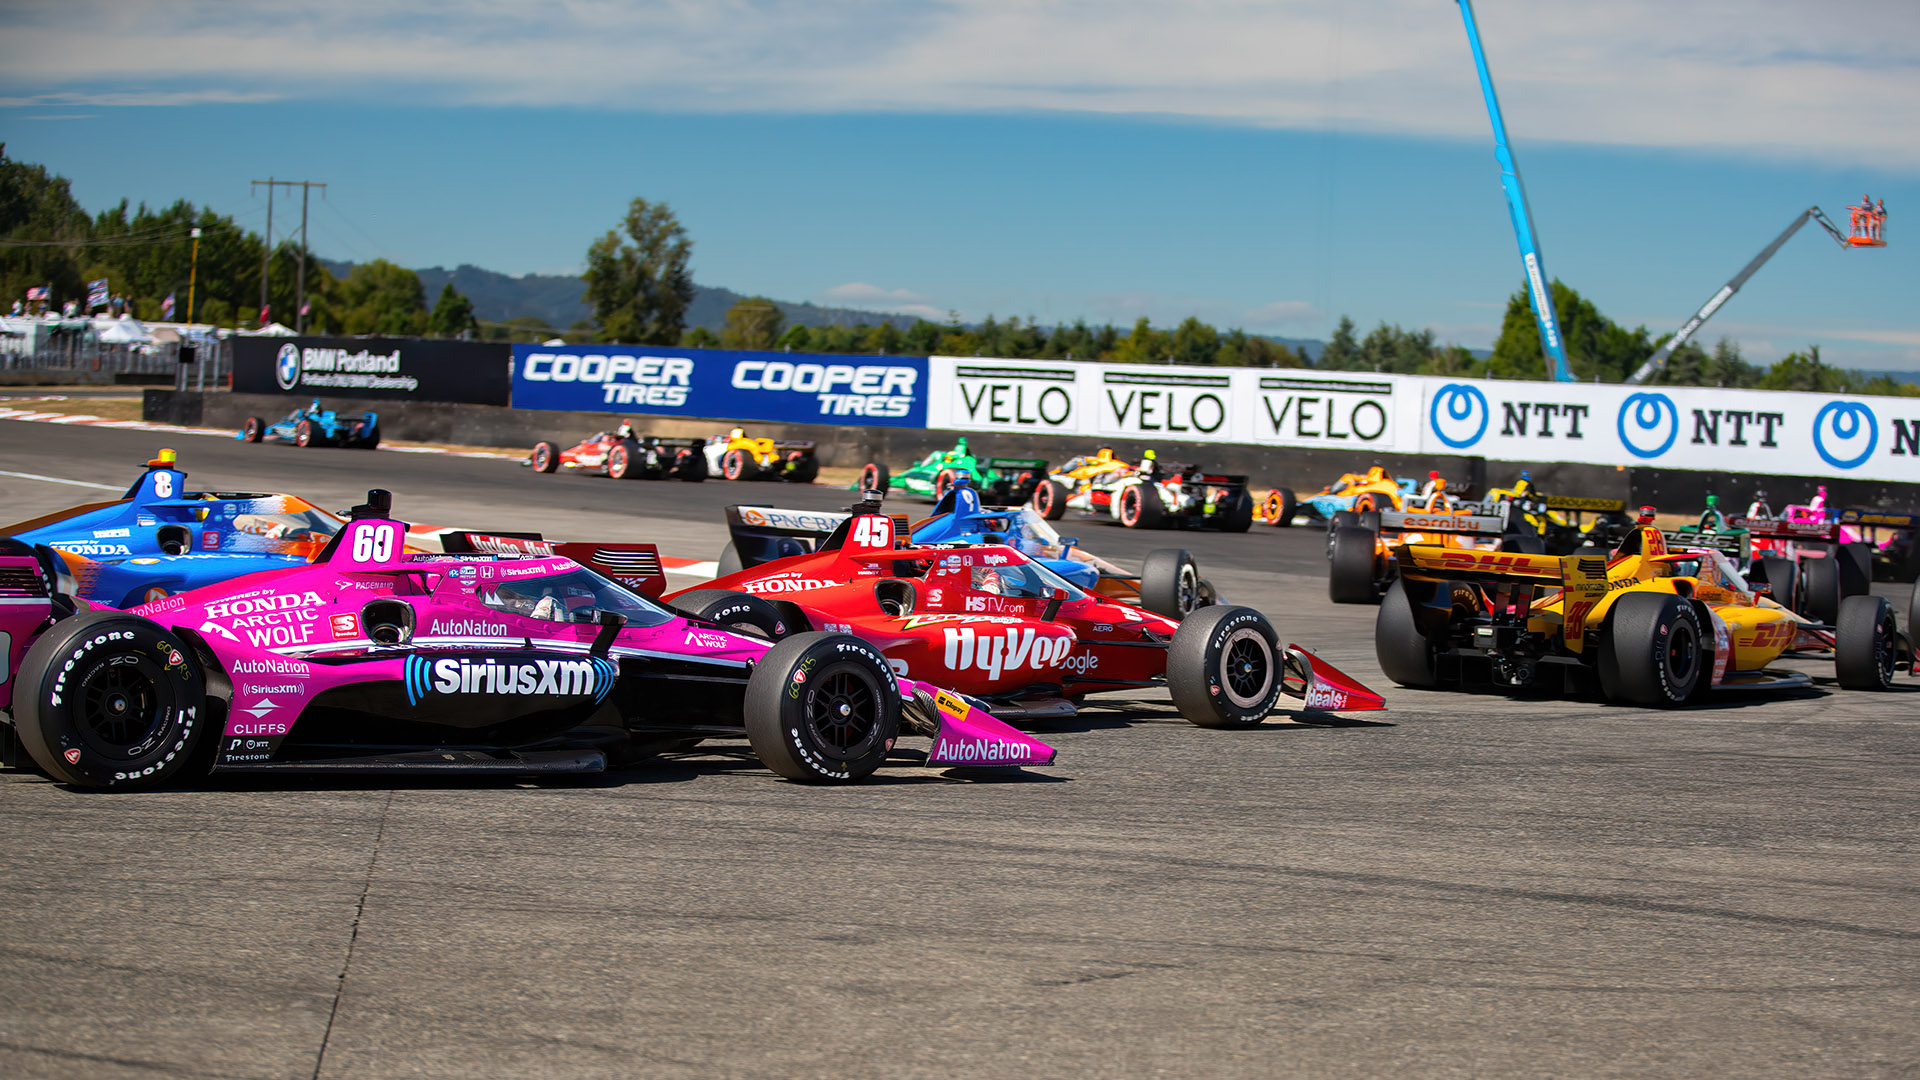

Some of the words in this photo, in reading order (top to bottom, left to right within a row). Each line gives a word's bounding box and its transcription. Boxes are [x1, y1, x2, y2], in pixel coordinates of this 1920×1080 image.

[302, 348, 336, 371] BMW
[336, 349, 401, 373] Portland
[523, 353, 694, 386] COOPER
[731, 361, 918, 396] COOPER
[602, 383, 692, 407] TIRES
[817, 394, 916, 418] TIRES
[960, 382, 1071, 425] VELO
[1106, 389, 1225, 433] VELO
[1263, 395, 1387, 440] VELO
[1501, 402, 1589, 438] NTT
[1690, 409, 1784, 448] NTT
[154, 471, 173, 498] 8
[962, 489, 974, 512] 9
[853, 516, 889, 547] 45
[1402, 516, 1479, 530] earnity
[352, 524, 395, 562] 60
[1440, 552, 1542, 574] DHL
[742, 578, 845, 594] HONDA
[1608, 576, 1641, 591] ONDA
[129, 596, 185, 617] toNation
[203, 591, 327, 620] HONDA
[204, 590, 260, 606] POWERED
[262, 588, 276, 597] by
[965, 596, 1025, 613] HSTV.com
[232, 608, 319, 629] ARCTIC
[430, 618, 507, 636] AutoNation
[1092, 624, 1114, 632] AERO
[246, 623, 314, 648] WOLF
[698, 632, 728, 642] ARCTIC
[1214, 614, 1258, 649] Firestone
[703, 639, 727, 649] WOLF
[943, 627, 1071, 681] HyVee
[52, 630, 136, 708] Firestone
[232, 659, 310, 674] AutoNation
[836, 642, 896, 693] Firestone
[945, 700, 964, 714] Clopay
[1308, 689, 1342, 708] deals
[234, 723, 286, 734] CLIFFS
[114, 705, 197, 780] Firestone
[790, 727, 851, 780] Firestone
[936, 738, 1031, 761] AutoNation
[226, 753, 270, 762] Firestone
